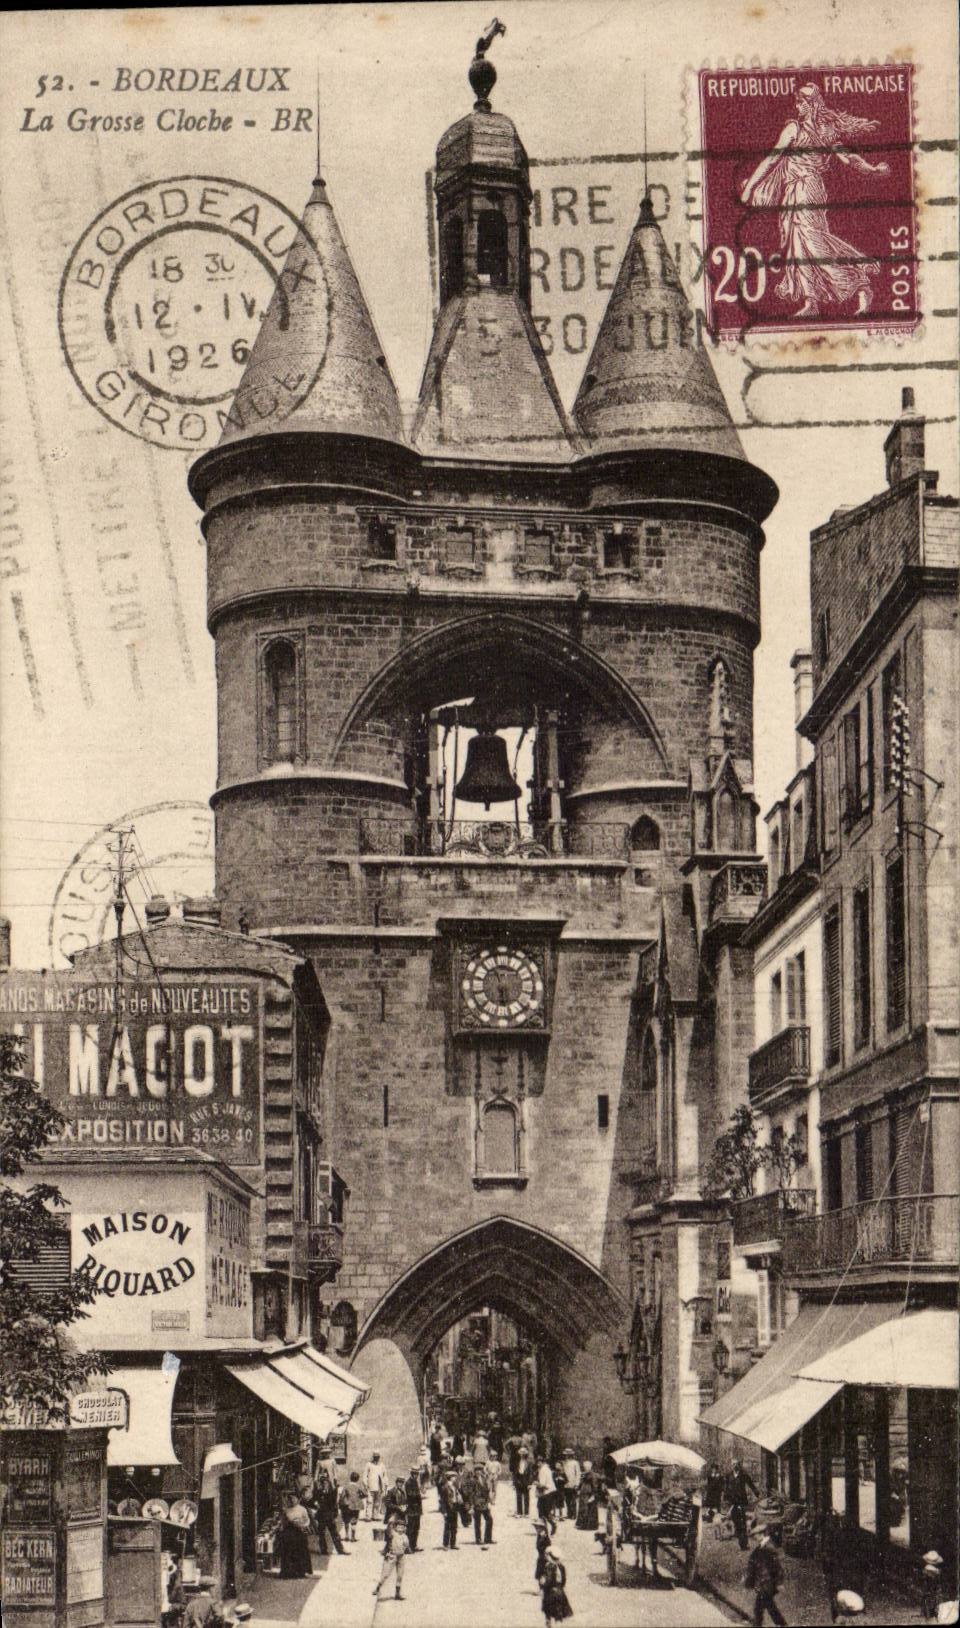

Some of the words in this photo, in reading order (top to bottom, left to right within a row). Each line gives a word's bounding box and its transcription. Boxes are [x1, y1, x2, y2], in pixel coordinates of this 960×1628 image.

[824, 74, 906, 95] FRANÇAISE
[889, 225, 911, 311] POSES
[130, 989, 148, 1014] de
[151, 987, 252, 1015] NOUVEAUTES
[69, 1022, 255, 1098] MAGOT
[80, 1211, 192, 1247] MAISON
[75, 1253, 196, 1298] RIQUARD
[78, 1396, 122, 1409] CHOCOLAT
